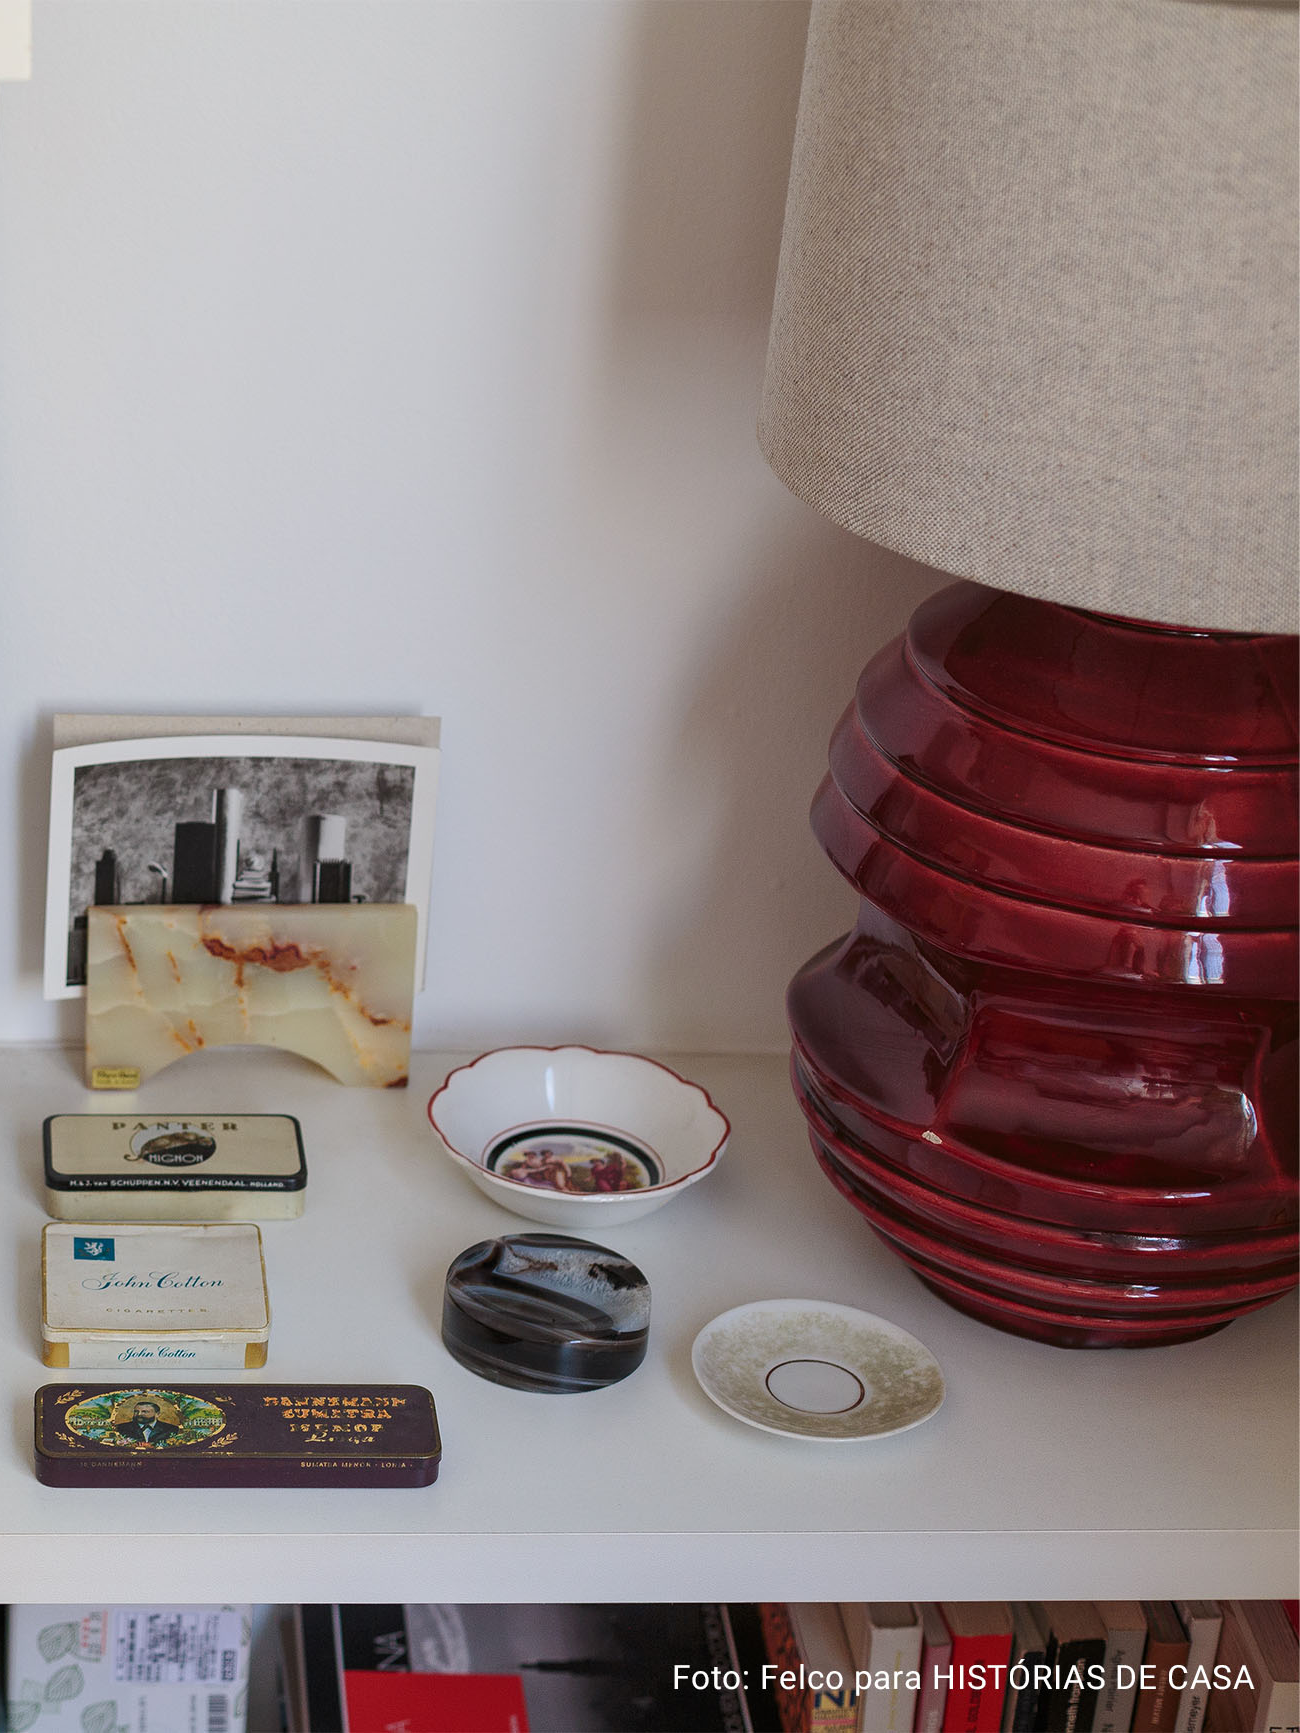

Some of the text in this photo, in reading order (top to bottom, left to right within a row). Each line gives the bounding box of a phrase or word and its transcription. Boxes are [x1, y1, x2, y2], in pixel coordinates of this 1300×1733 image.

[111, 1121, 239, 1132] PANTER
[148, 1153, 204, 1163] MIGNON
[81, 1271, 225, 1291] John Cotton
[117, 1347, 155, 1362] John
[156, 1346, 197, 1359] Cotton
